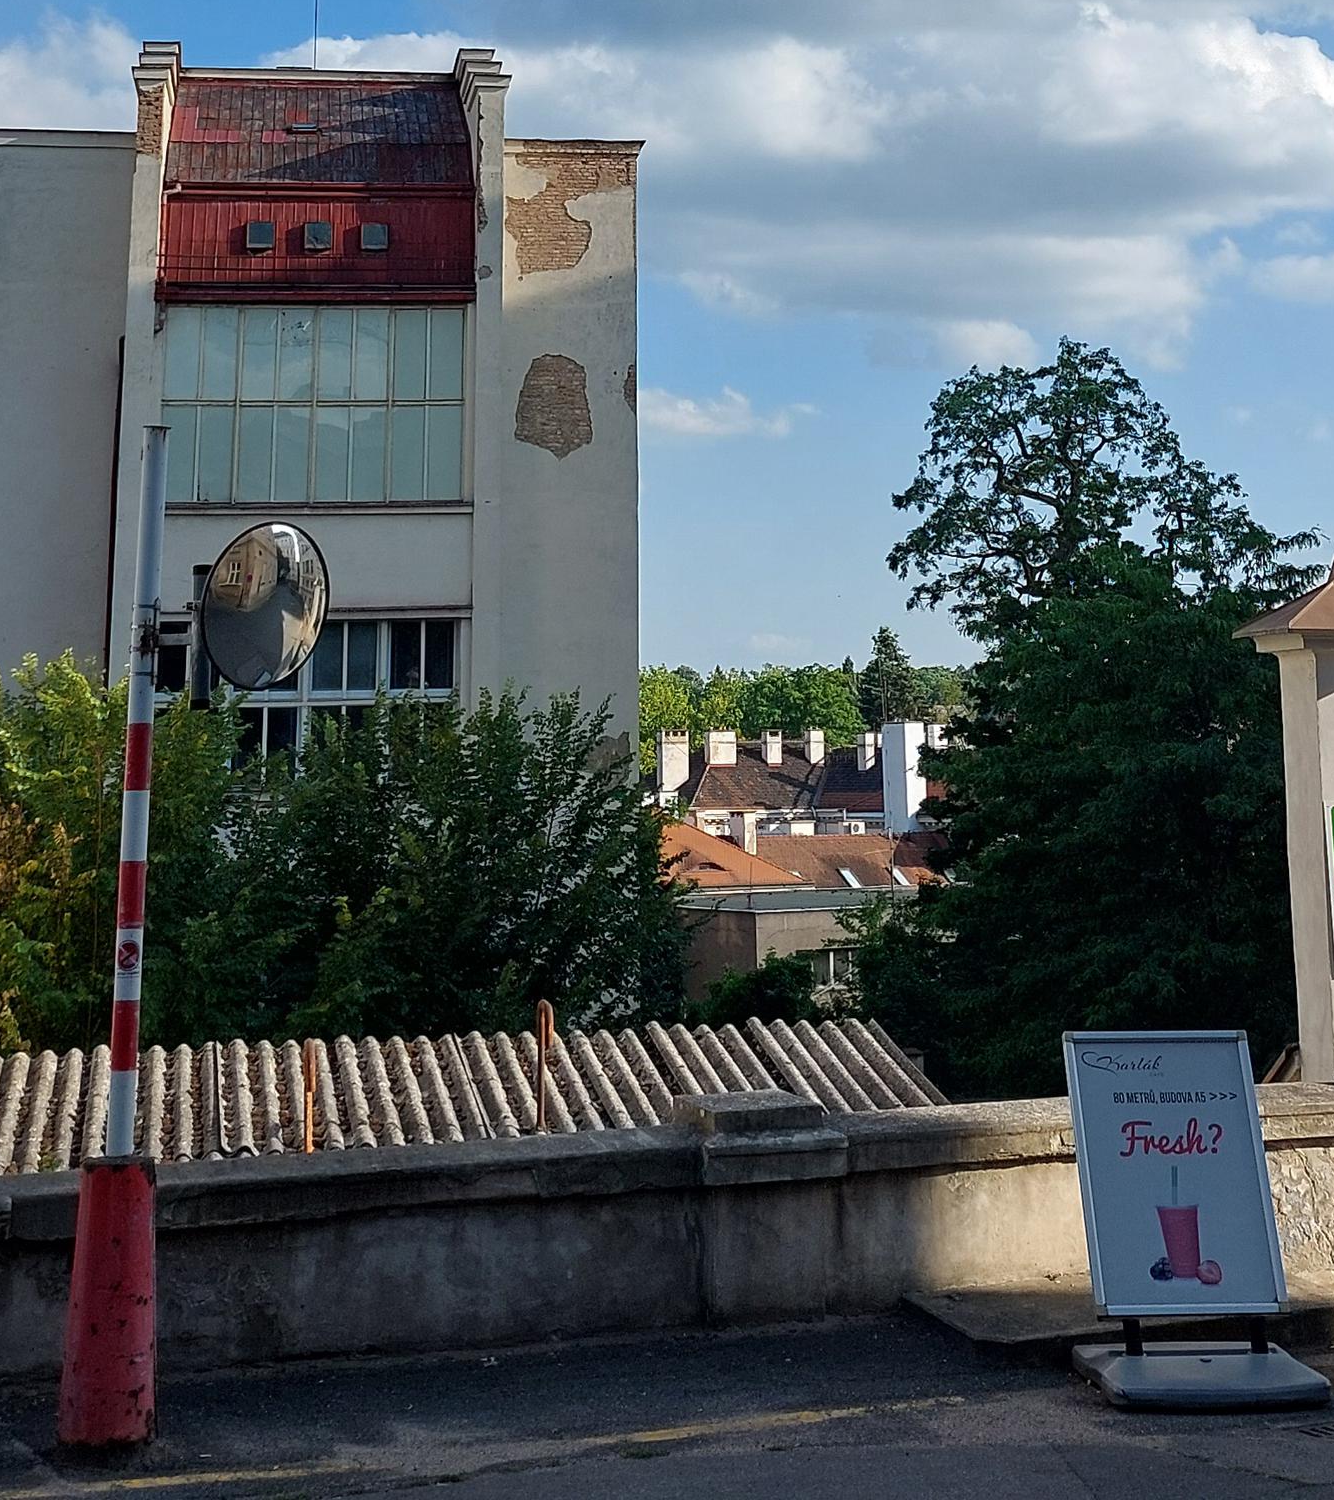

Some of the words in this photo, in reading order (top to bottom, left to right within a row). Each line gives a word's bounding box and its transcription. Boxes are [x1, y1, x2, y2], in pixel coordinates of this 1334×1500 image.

[1081, 1051, 1163, 1077] Karlák
[1113, 1092, 1124, 1104] 80
[1126, 1089, 1158, 1104] METRŮ,
[1160, 1092, 1194, 1104] BUDOVA
[1195, 1092, 1206, 1103] A5
[1119, 1117, 1223, 1158] Fresh?
